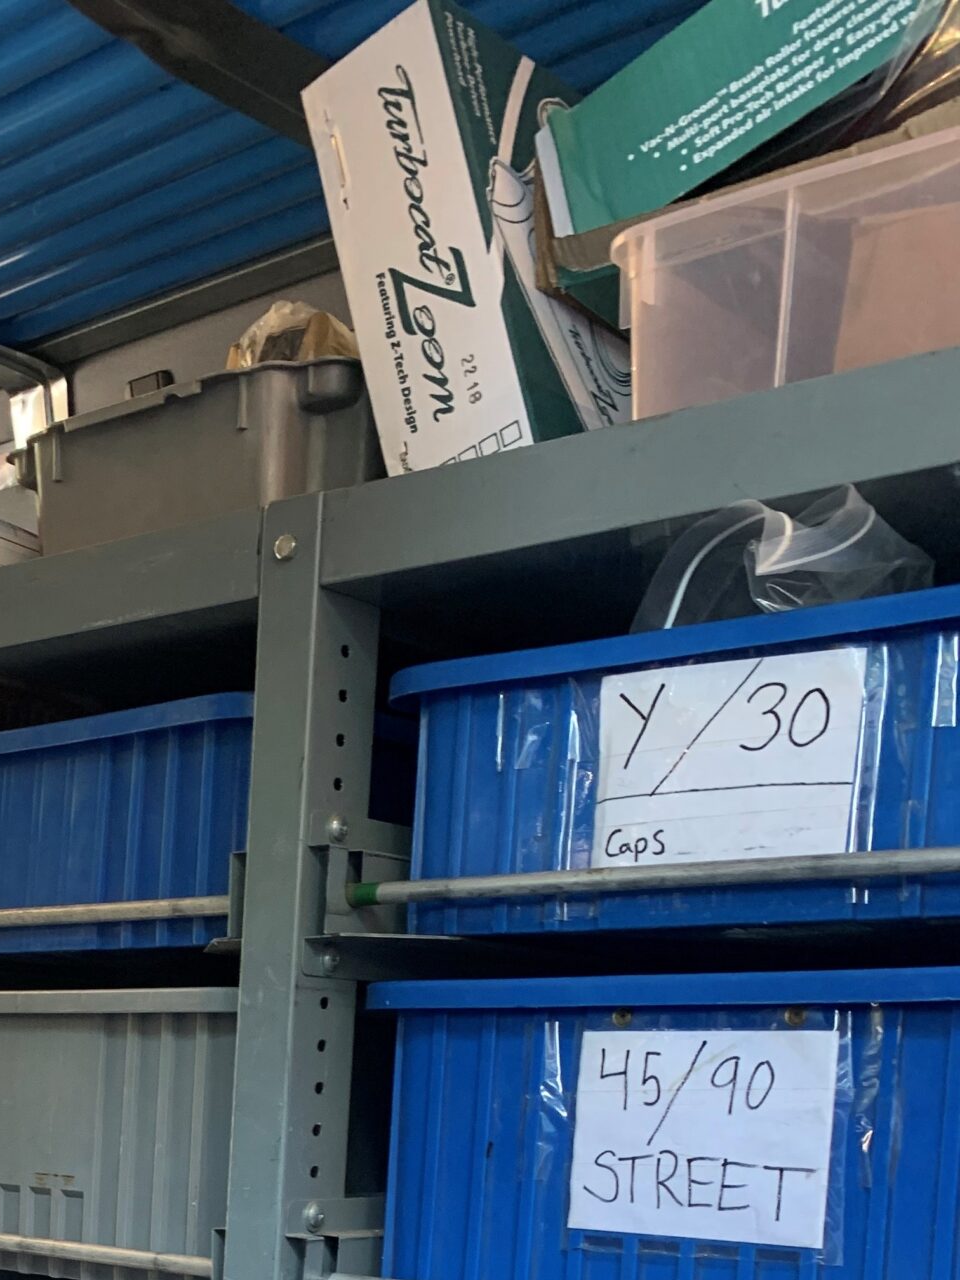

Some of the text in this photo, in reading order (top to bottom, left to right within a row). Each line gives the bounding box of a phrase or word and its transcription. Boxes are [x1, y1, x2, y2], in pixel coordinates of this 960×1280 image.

[667, 104, 729, 151] Multi-port
[730, 64, 790, 108] baseplate
[791, 49, 811, 66] for
[813, 27, 845, 52] deep
[692, 118, 754, 163] Expanded
[755, 107, 772, 123] air
[773, 80, 815, 110] intake
[816, 65, 836, 82] for
[836, 20, 899, 68] improved
[729, 65, 764, 93] Brush
[765, 39, 802, 68] Roller
[803, 2, 856, 41] features
[694, 56, 826, 147] Soft Pro-Tech Bumper
[374, 272, 398, 340] Featuring
[390, 340, 409, 385] Z-Tech
[400, 386, 418, 434] Design
[387, 246, 477, 423] Zoom
[604, 828, 666, 863] Caps
[599, 1040, 776, 1147] 45/90
[583, 1150, 816, 1222] STREET
